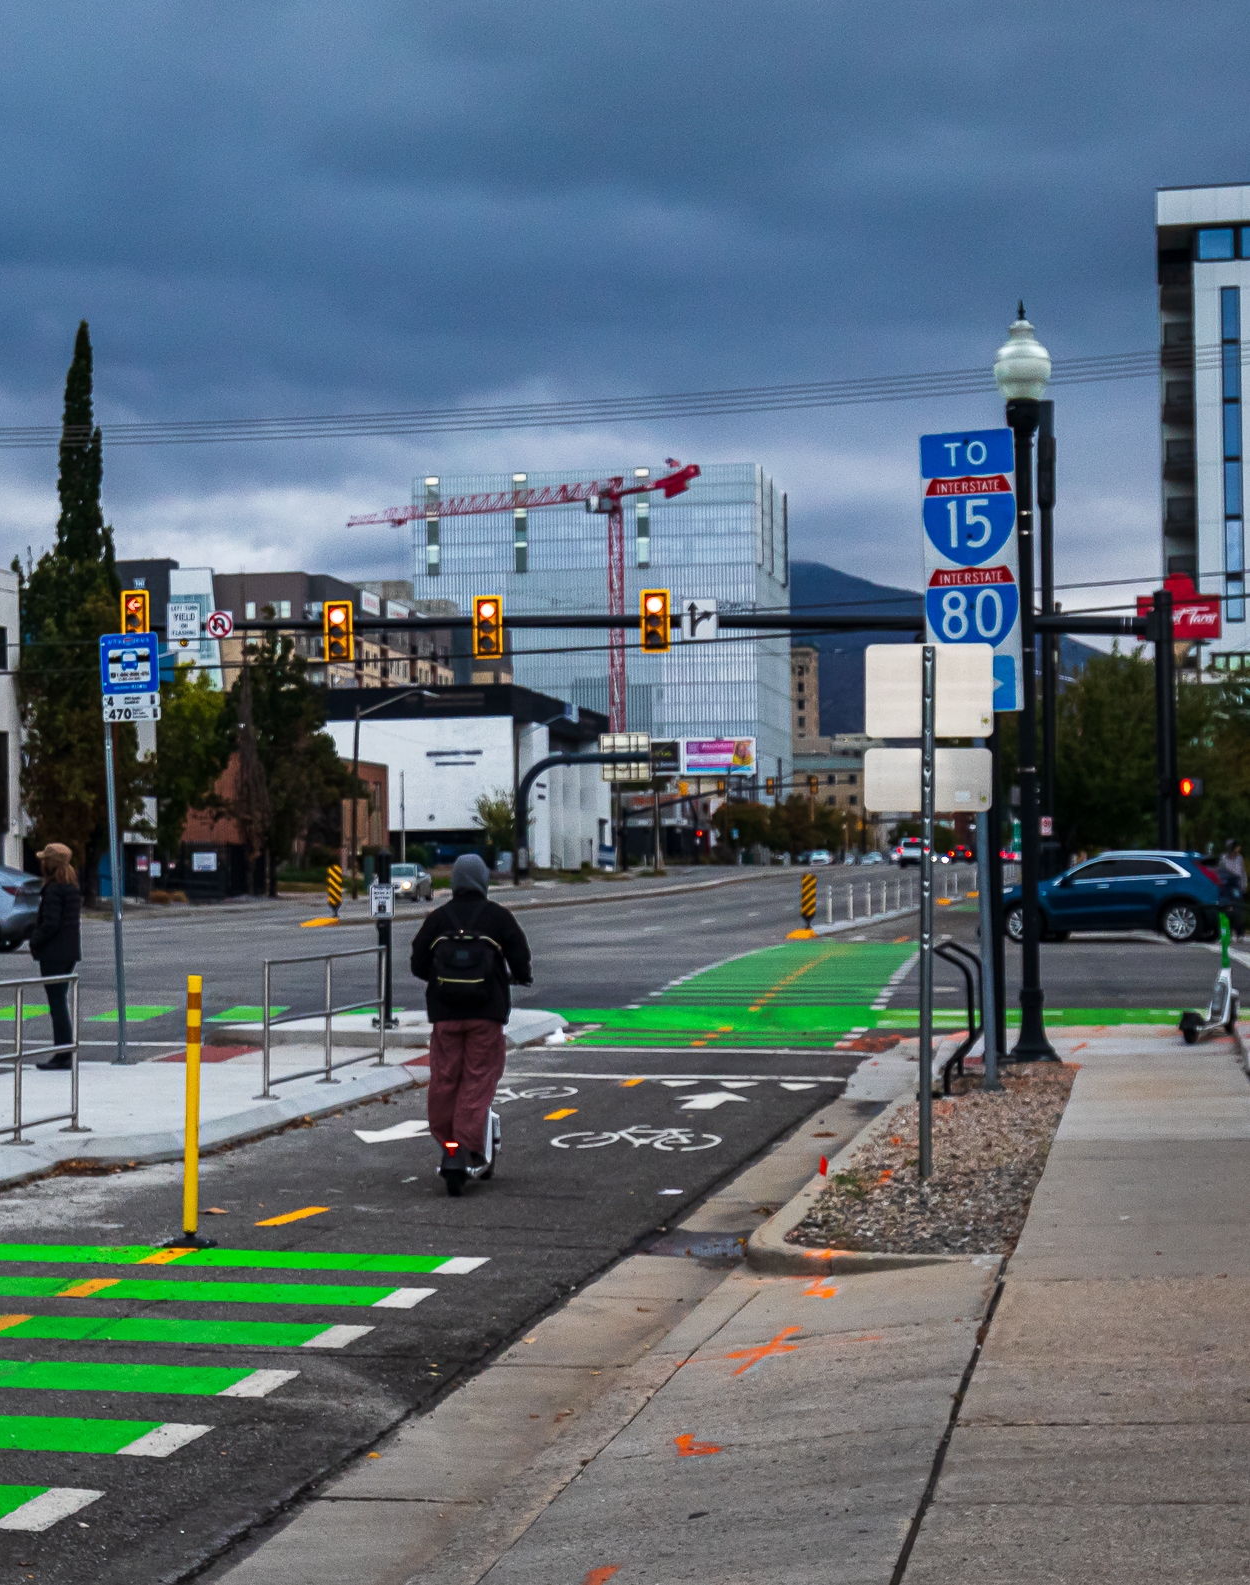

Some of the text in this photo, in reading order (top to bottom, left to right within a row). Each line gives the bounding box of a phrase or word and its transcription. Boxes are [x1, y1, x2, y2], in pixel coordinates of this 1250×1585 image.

[943, 440, 988, 467] TO
[936, 478, 1001, 494] INTERSTATE
[947, 498, 993, 549] 15
[938, 570, 1004, 585] INTERSTATE
[173, 612, 196, 621] YIELD
[942, 588, 1004, 640] 80
[107, 695, 114, 707] 4
[108, 707, 132, 720] 470
